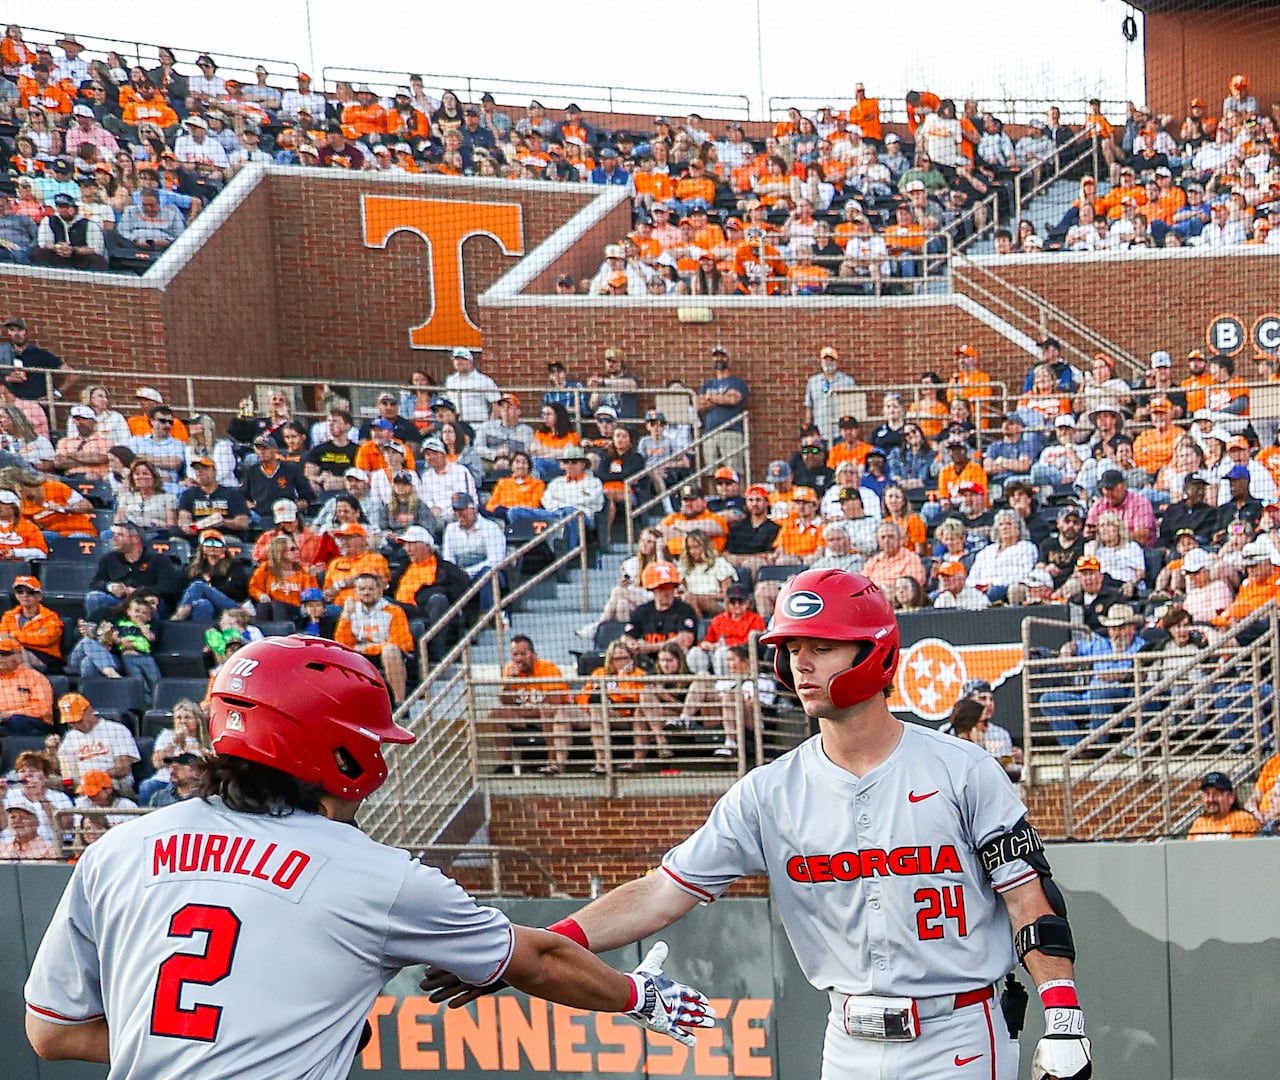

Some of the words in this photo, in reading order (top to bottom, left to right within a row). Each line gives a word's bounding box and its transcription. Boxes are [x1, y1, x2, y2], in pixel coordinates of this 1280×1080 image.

[361, 193, 524, 351] T
[1217, 323, 1238, 348] B
[1258, 321, 1280, 347] C
[781, 590, 825, 620] G
[229, 711, 241, 730] 2
[153, 834, 311, 892] MURILLO
[786, 845, 962, 883] GEORGIA
[914, 885, 968, 940] 24
[151, 903, 241, 1043] 2
